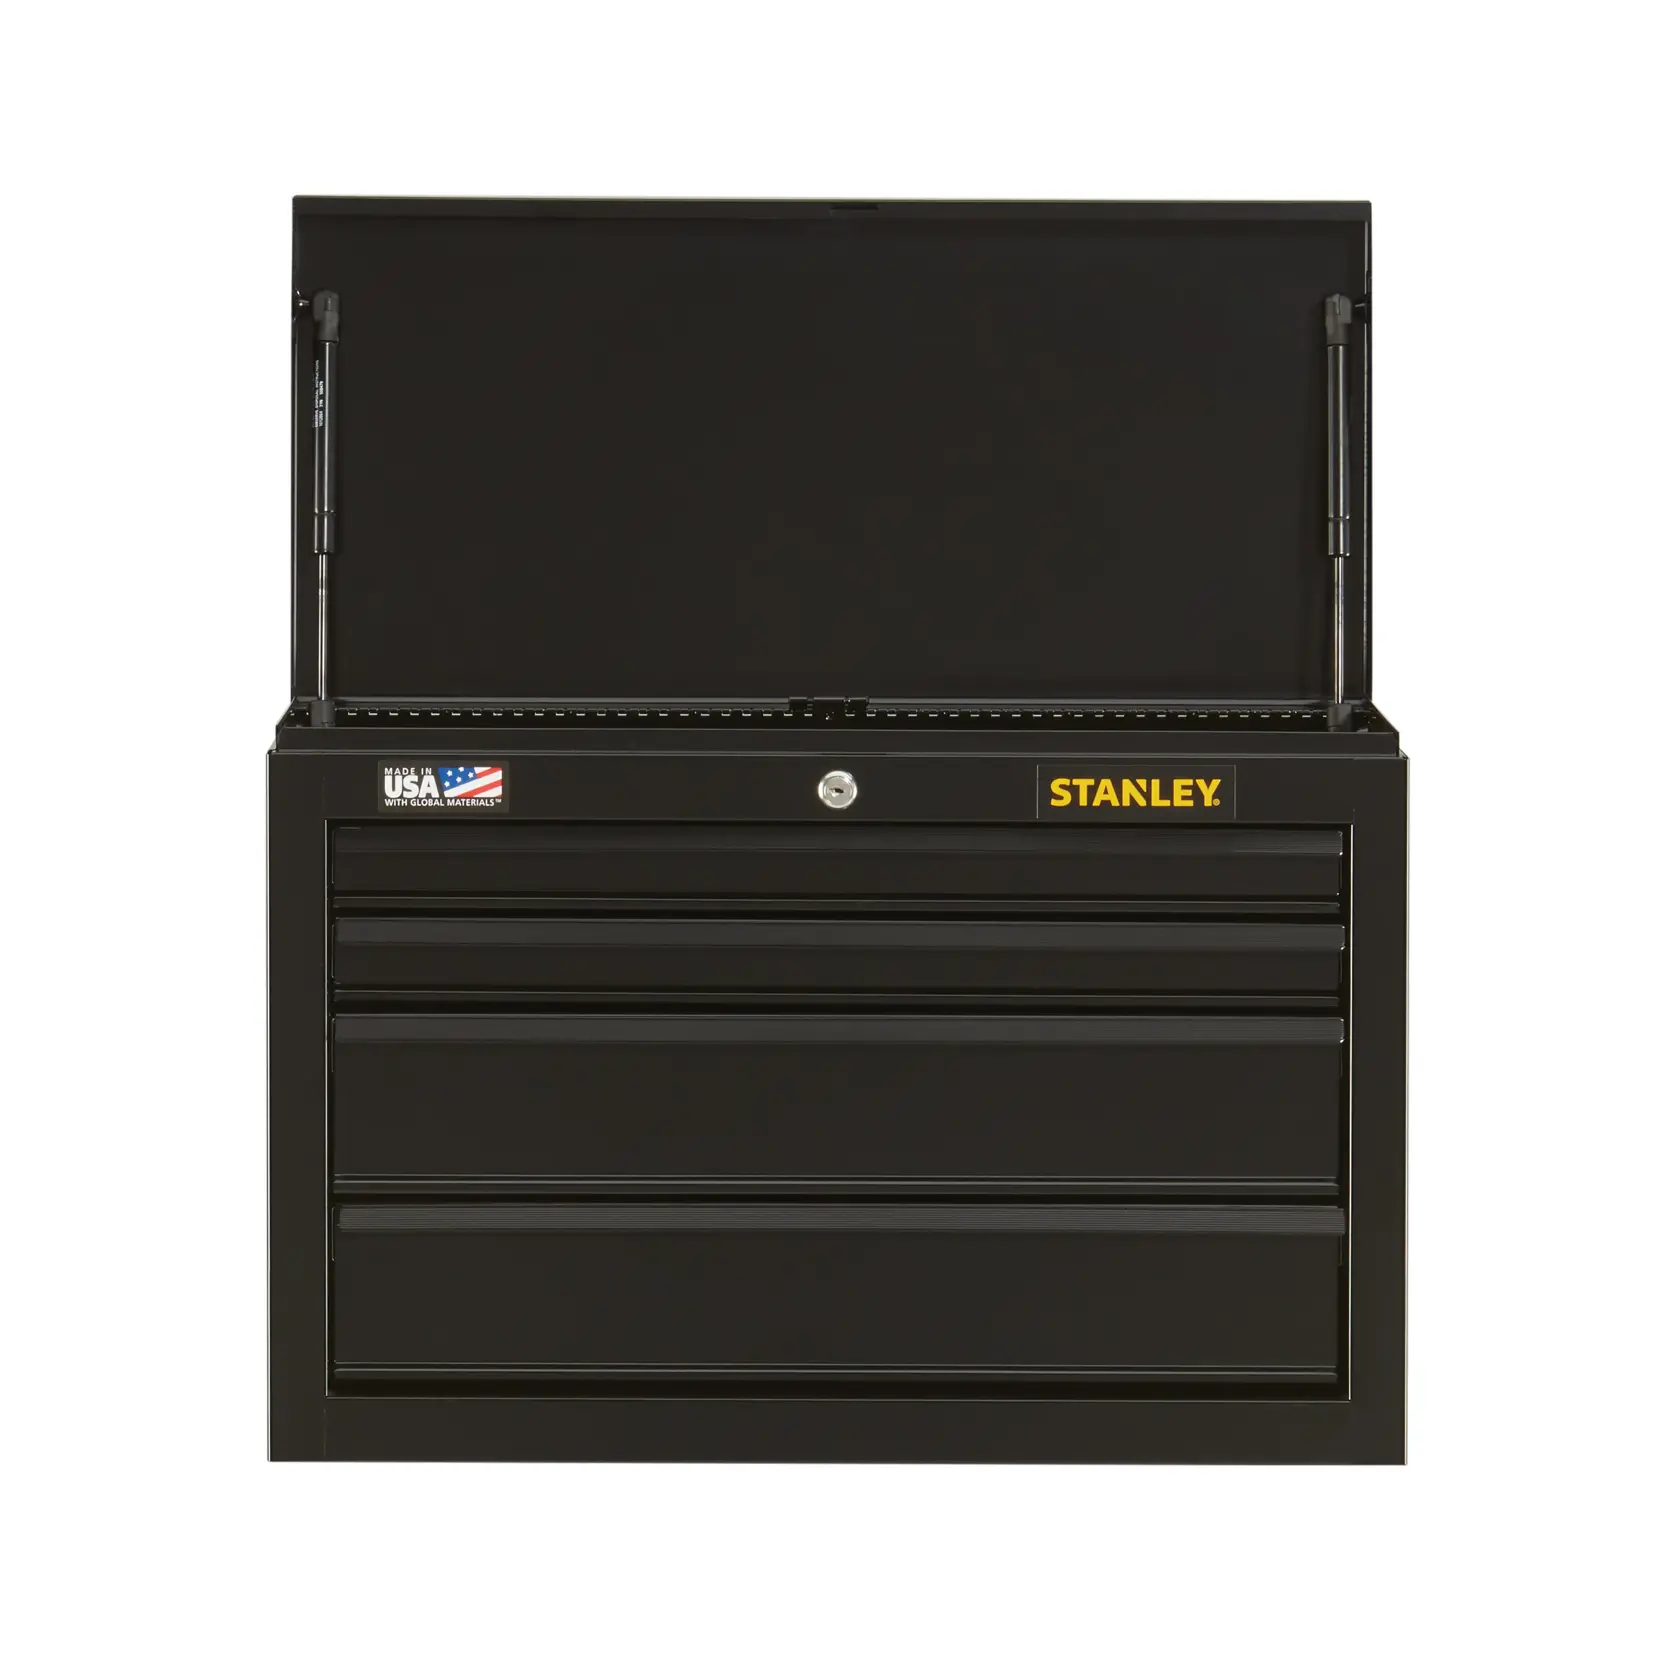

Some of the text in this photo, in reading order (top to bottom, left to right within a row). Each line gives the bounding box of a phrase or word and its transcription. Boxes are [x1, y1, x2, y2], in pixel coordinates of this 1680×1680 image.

[384, 767, 432, 775] MADE IN
[384, 775, 440, 798] USA
[1050, 778, 1221, 807] STANLEY
[384, 798, 408, 806] WITH
[410, 798, 445, 806] GLOBAL
